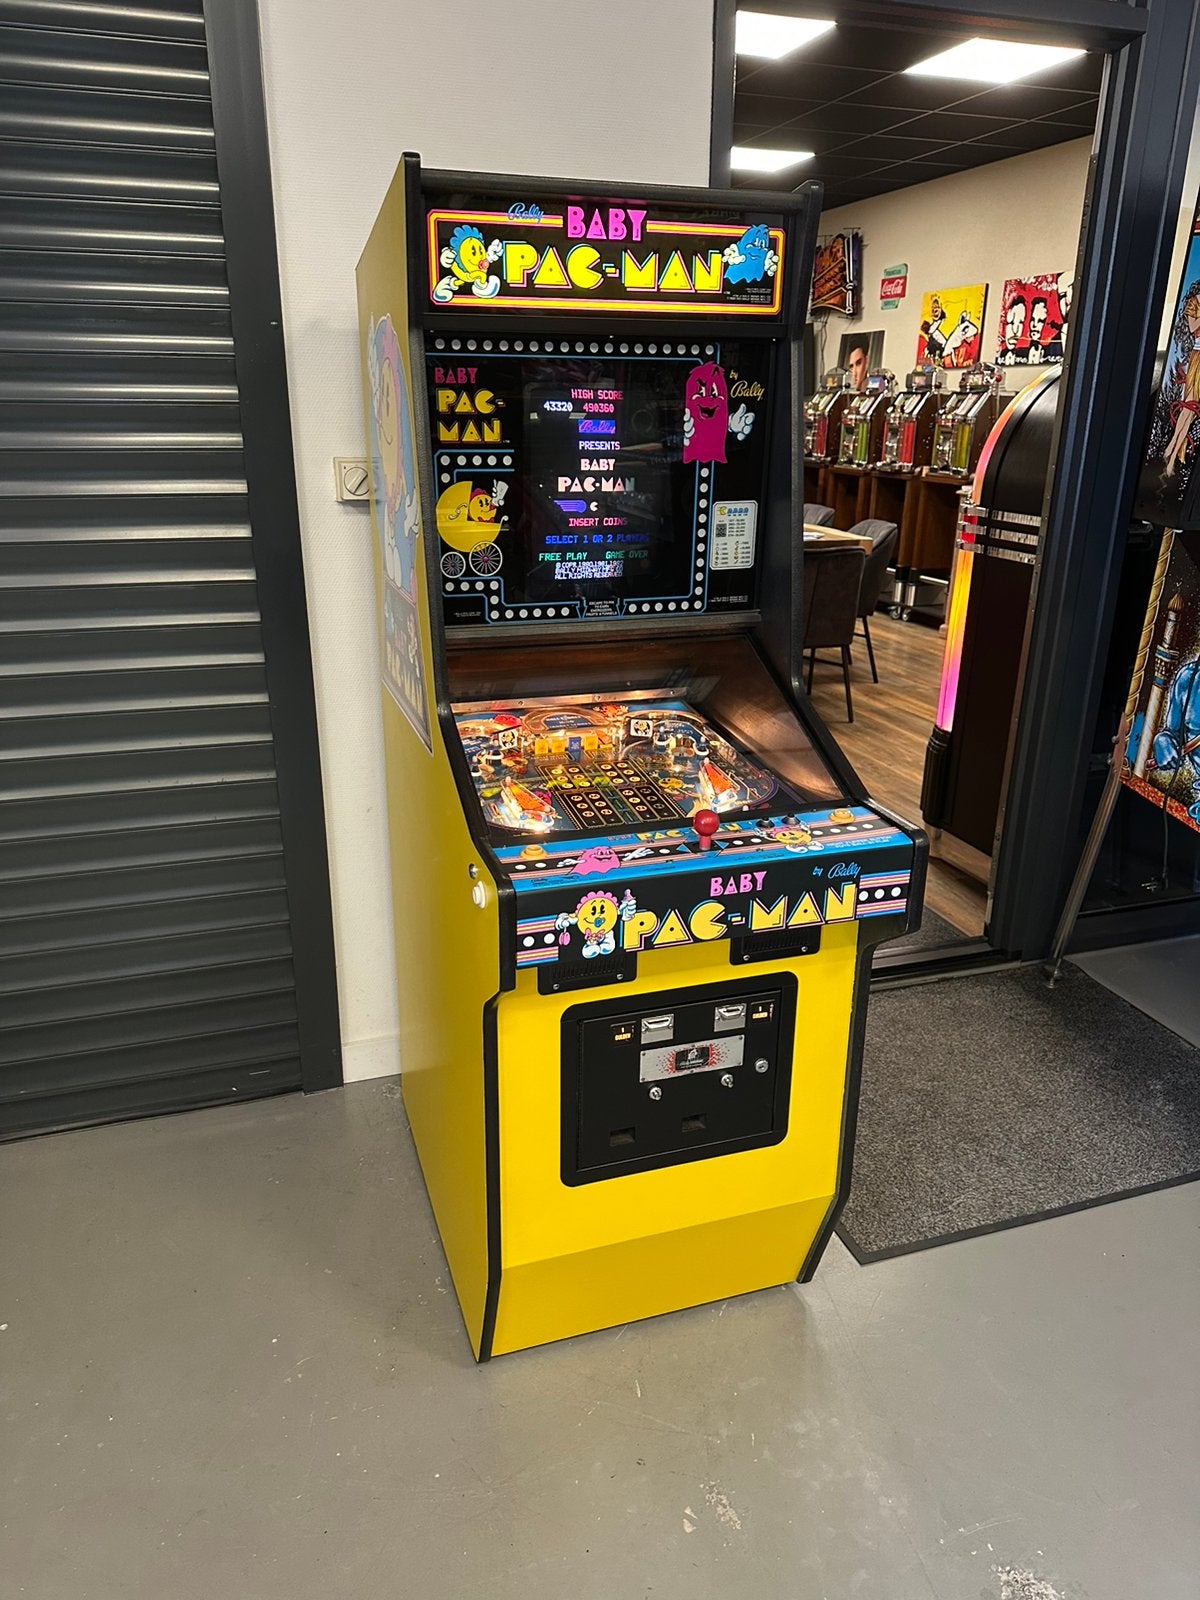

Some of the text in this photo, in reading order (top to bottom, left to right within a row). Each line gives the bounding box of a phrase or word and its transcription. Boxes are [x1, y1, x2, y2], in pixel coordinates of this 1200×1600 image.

[506, 202, 545, 224] Bally
[567, 206, 647, 242] BABY
[502, 240, 725, 294] PAC-MAN
[434, 367, 478, 384] BABY
[729, 369, 739, 380] by
[571, 388, 623, 400] HIGH SCORE
[730, 380, 765, 402] Bally
[436, 388, 506, 415] PAC-
[543, 400, 615, 413] 43320 490360
[437, 418, 503, 444] MAN
[578, 419, 616, 434] Bally
[579, 441, 621, 450] PRESENTS
[580, 458, 616, 471] BABY
[568, 517, 628, 527] INSERT COINS
[545, 535, 578, 544] SELECT
[583, 535, 588, 544] 1
[592, 534, 603, 544] OR
[607, 534, 613, 543] 2
[538, 552, 588, 562] FREE PLAY
[605, 550, 648, 559] GAME OVER
[812, 861, 861, 879] by Bally
[709, 870, 767, 897] BABY
[619, 881, 858, 952] PAC-MAN
